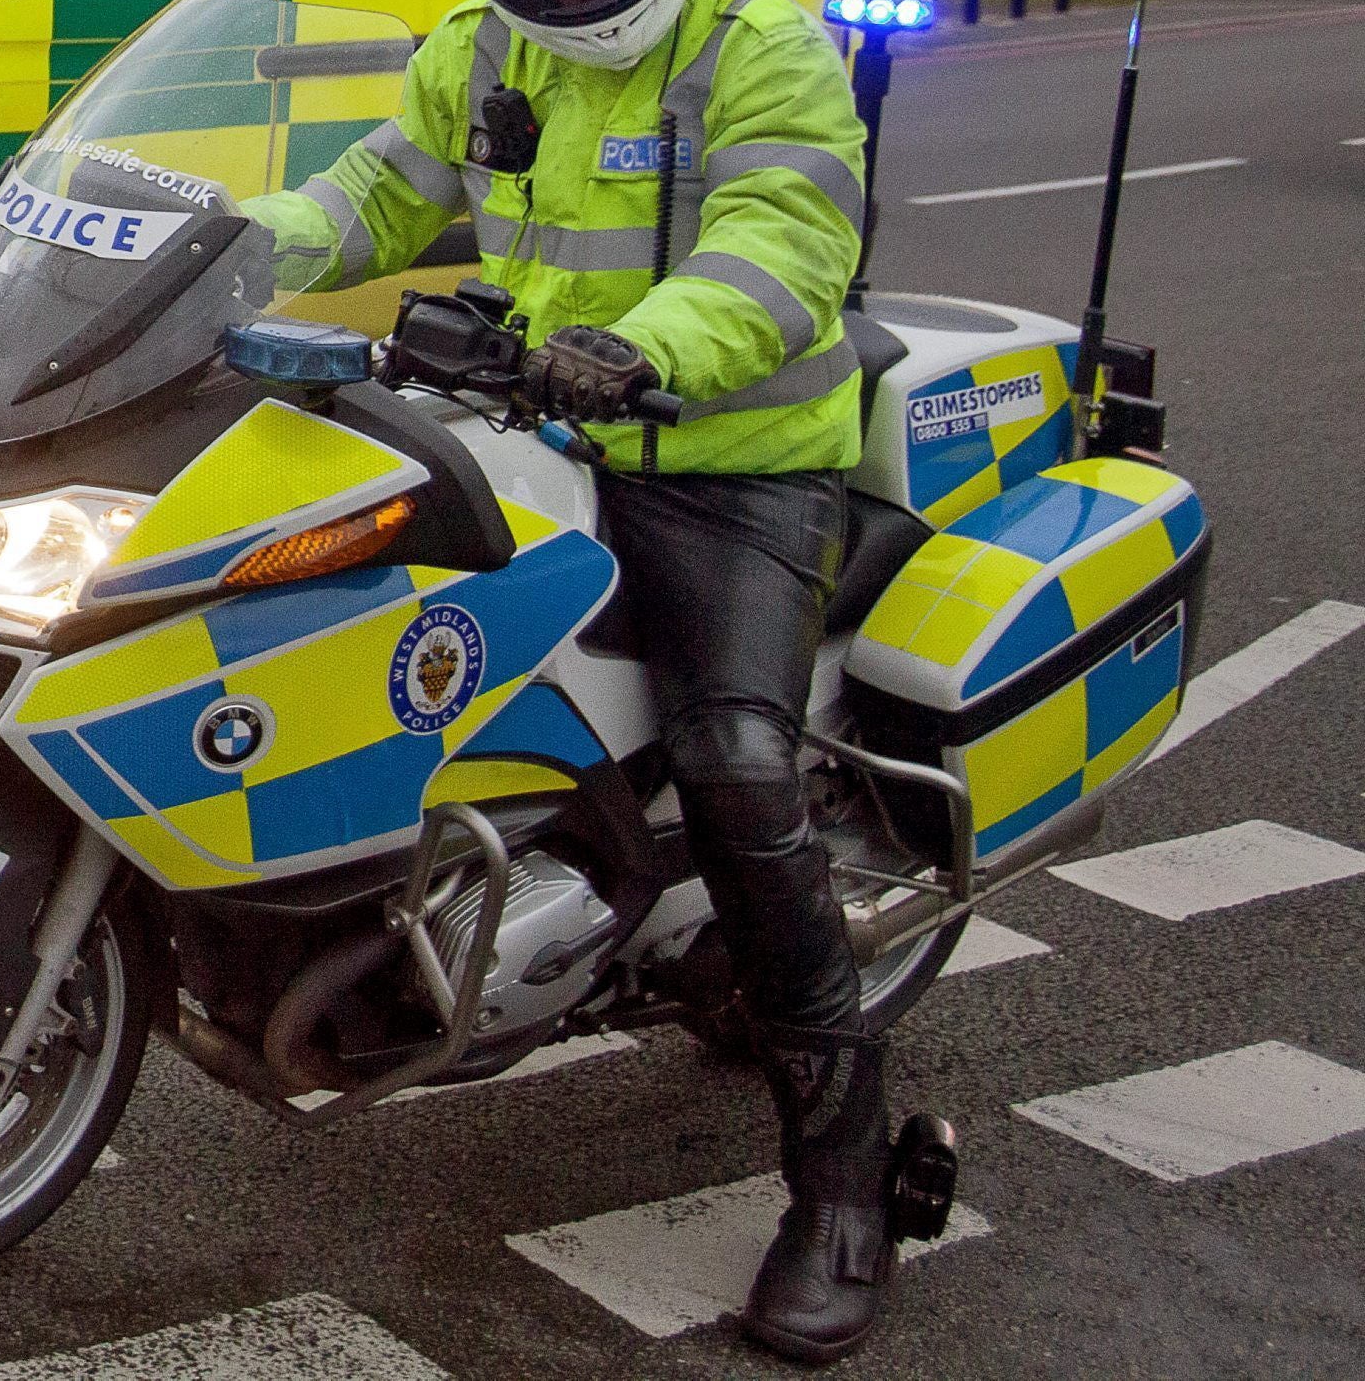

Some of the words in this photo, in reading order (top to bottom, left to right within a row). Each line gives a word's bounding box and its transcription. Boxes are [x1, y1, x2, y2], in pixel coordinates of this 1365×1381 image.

[909, 373, 1042, 423] CRIMESTOPPERS
[392, 630, 419, 682] WEST
[421, 611, 479, 670] MIDLANDS
[402, 702, 462, 730] POLICE
